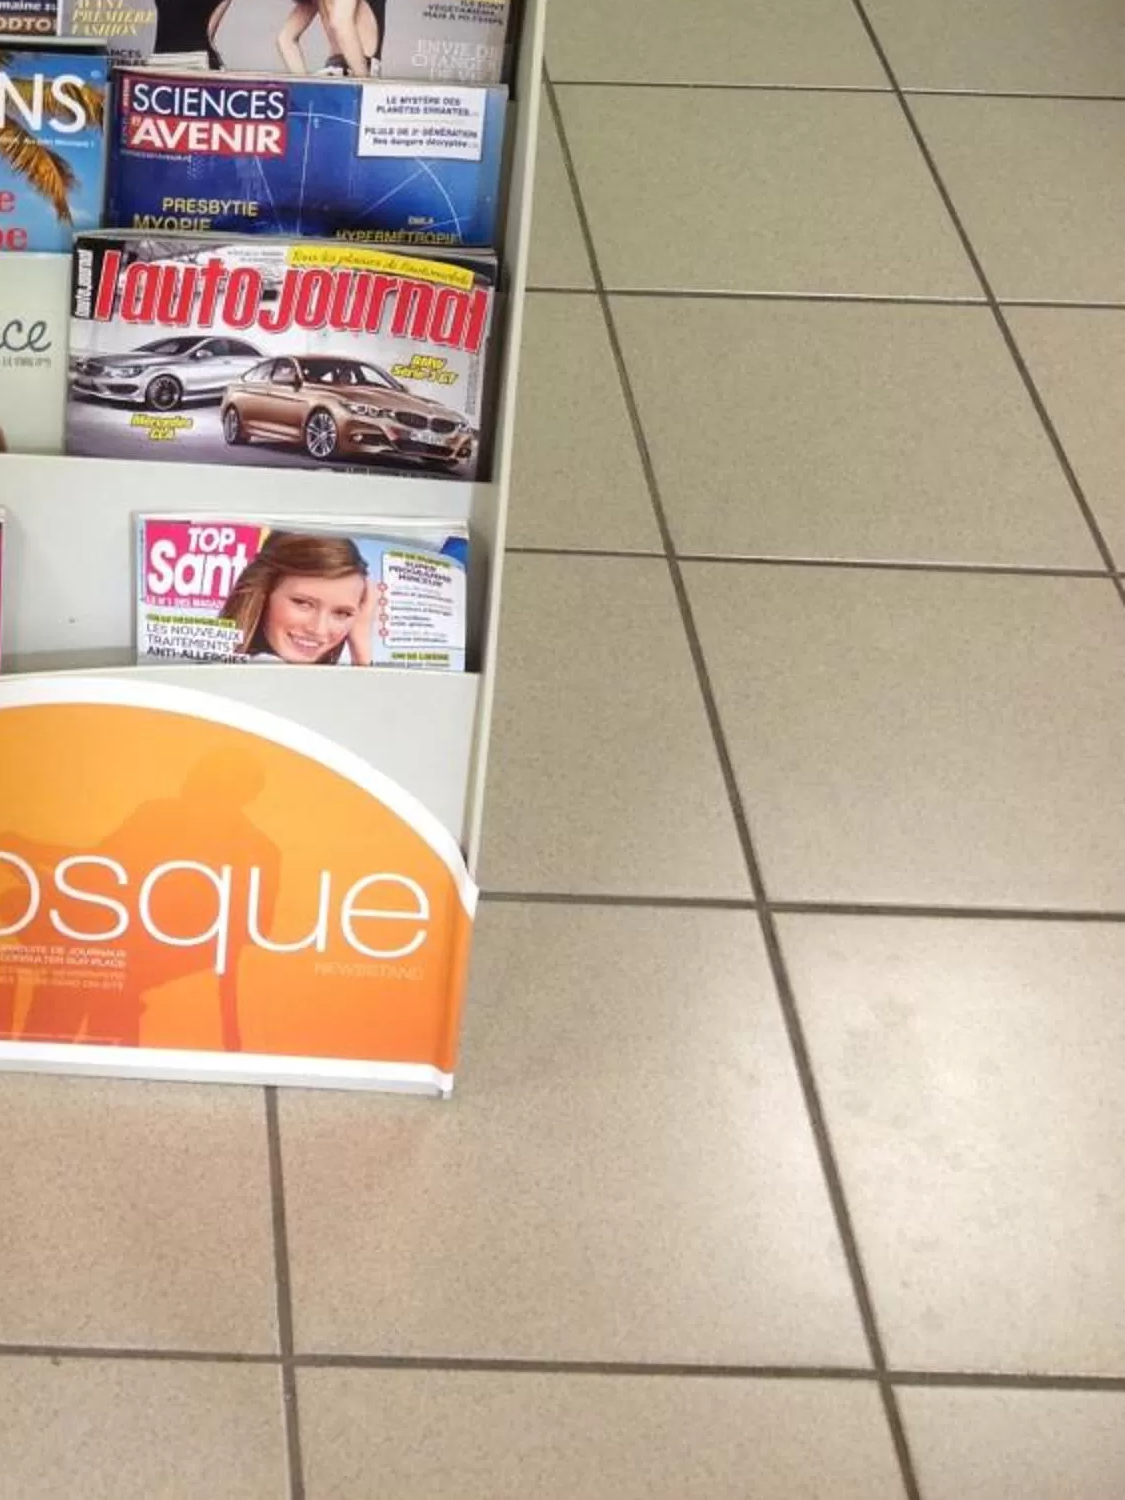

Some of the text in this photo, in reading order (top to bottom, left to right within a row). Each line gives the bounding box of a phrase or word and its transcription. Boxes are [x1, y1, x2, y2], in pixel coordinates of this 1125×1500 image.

[132, 83, 285, 120] SCIENCES
[130, 117, 284, 156] AVENIR
[162, 197, 259, 217] PRESBYTIE
[133, 213, 213, 232] MYOPIE
[188, 527, 236, 553] TOP
[148, 538, 248, 598] Sant
[146, 622, 240, 641] LES NOUVEAUX
